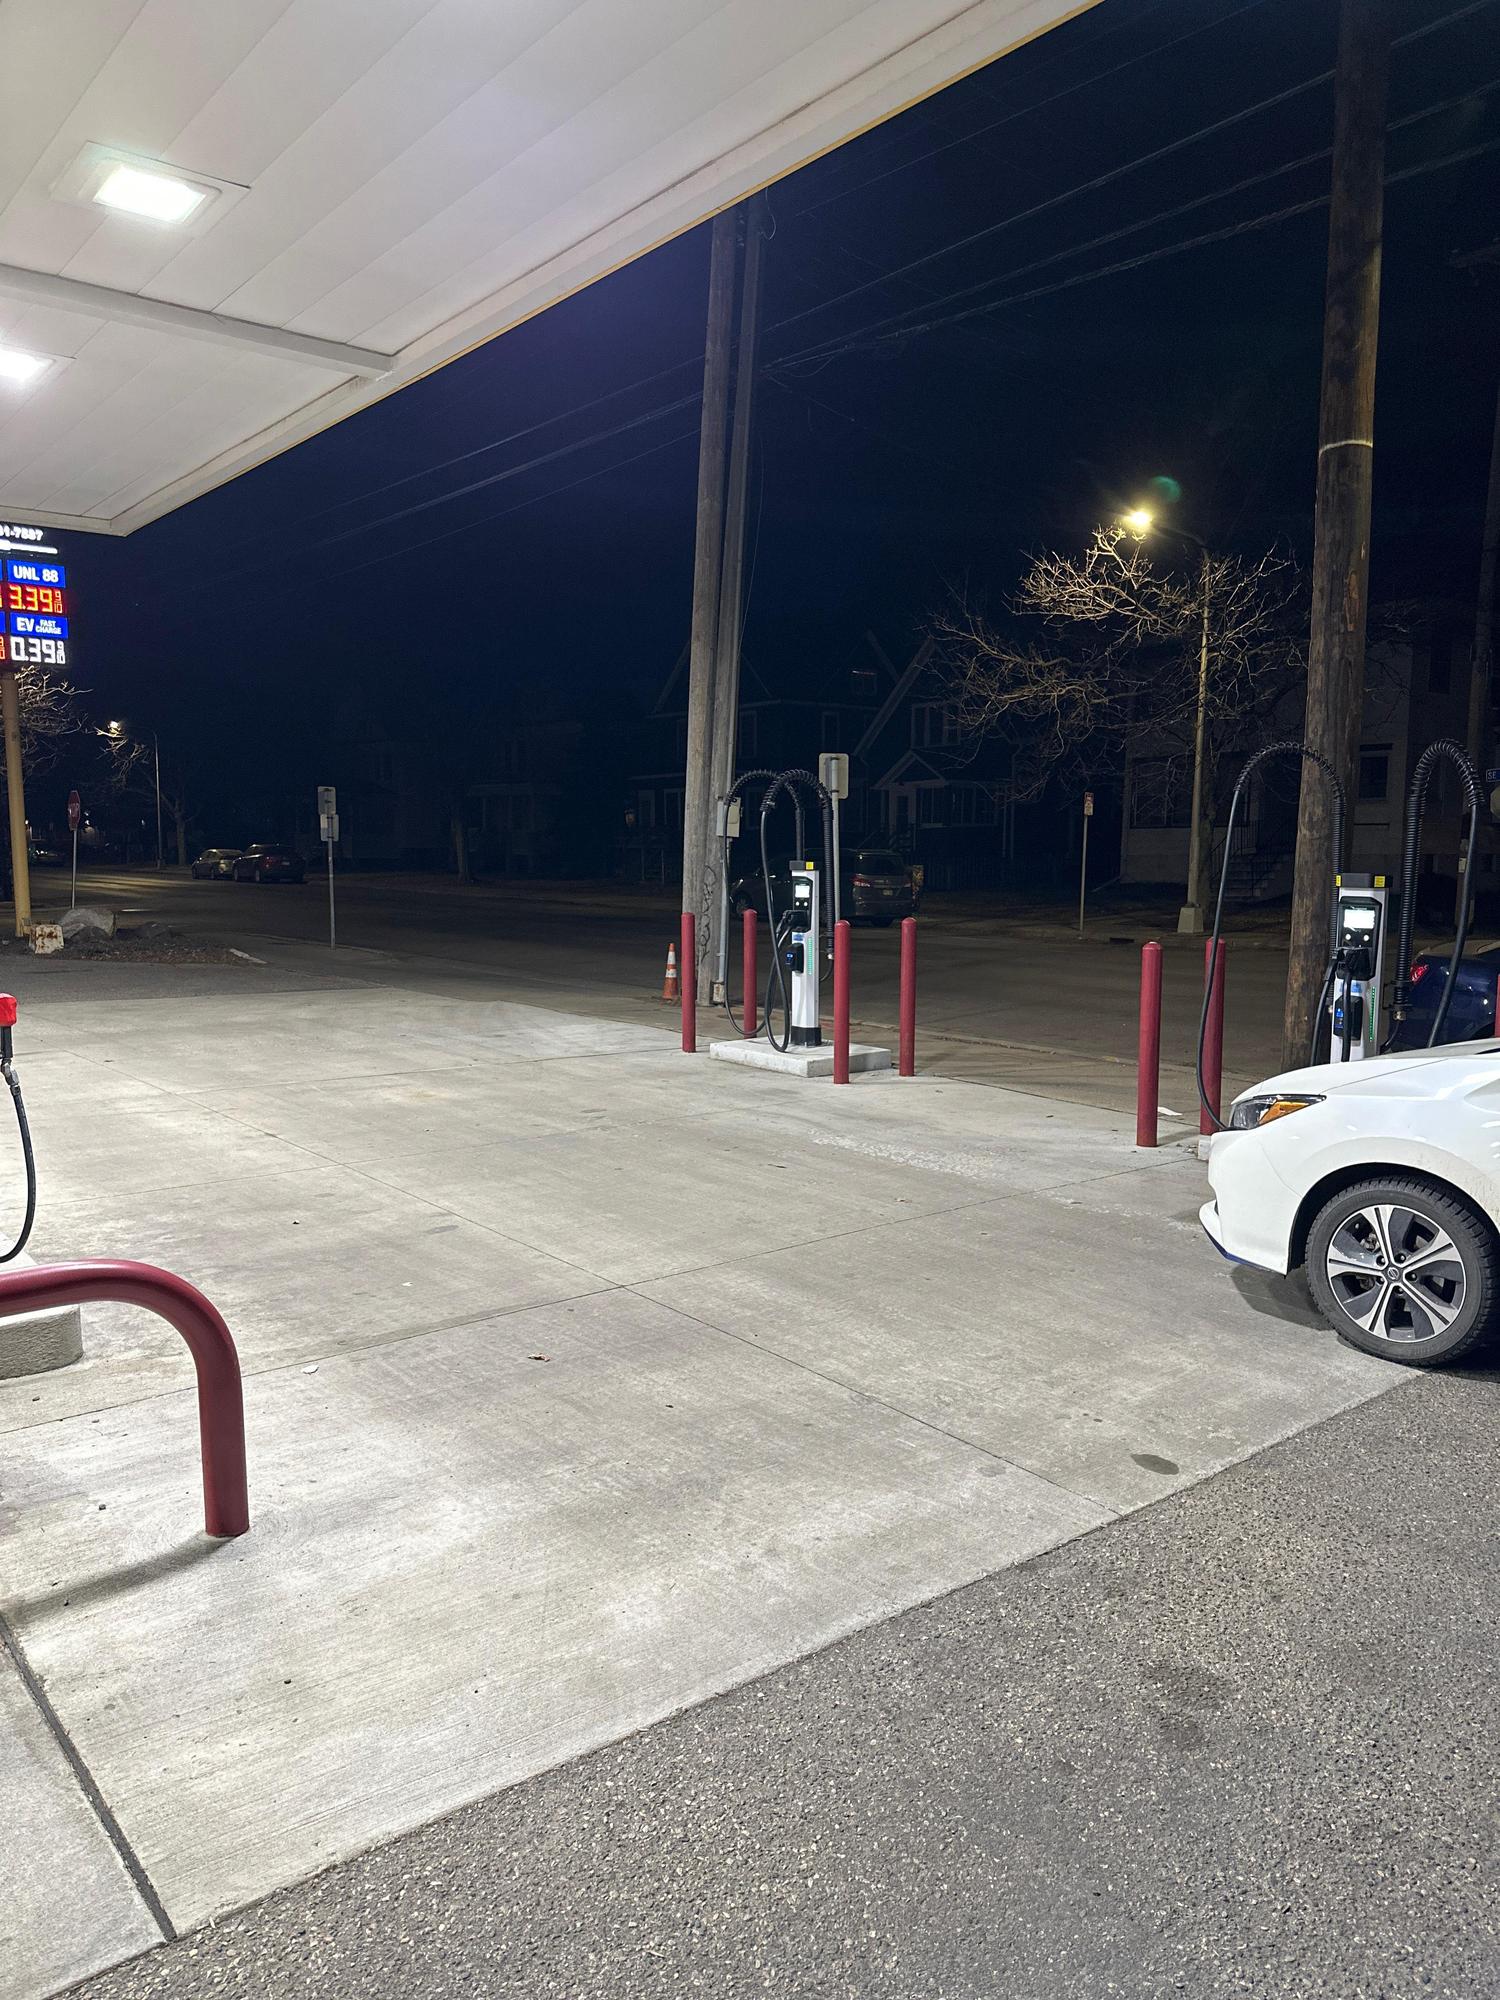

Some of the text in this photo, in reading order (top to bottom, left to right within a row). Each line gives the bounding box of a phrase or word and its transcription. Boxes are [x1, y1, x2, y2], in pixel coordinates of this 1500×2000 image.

[13, 565, 59, 583] UNL 88
[9, 584, 53, 613] 3.39
[17, 617, 34, 632] EV
[35, 625, 62, 635] CHARGE
[40, 619, 56, 628] FAST
[10, 635, 56, 664] 0.39
[1487, 771, 1497, 780] SE
